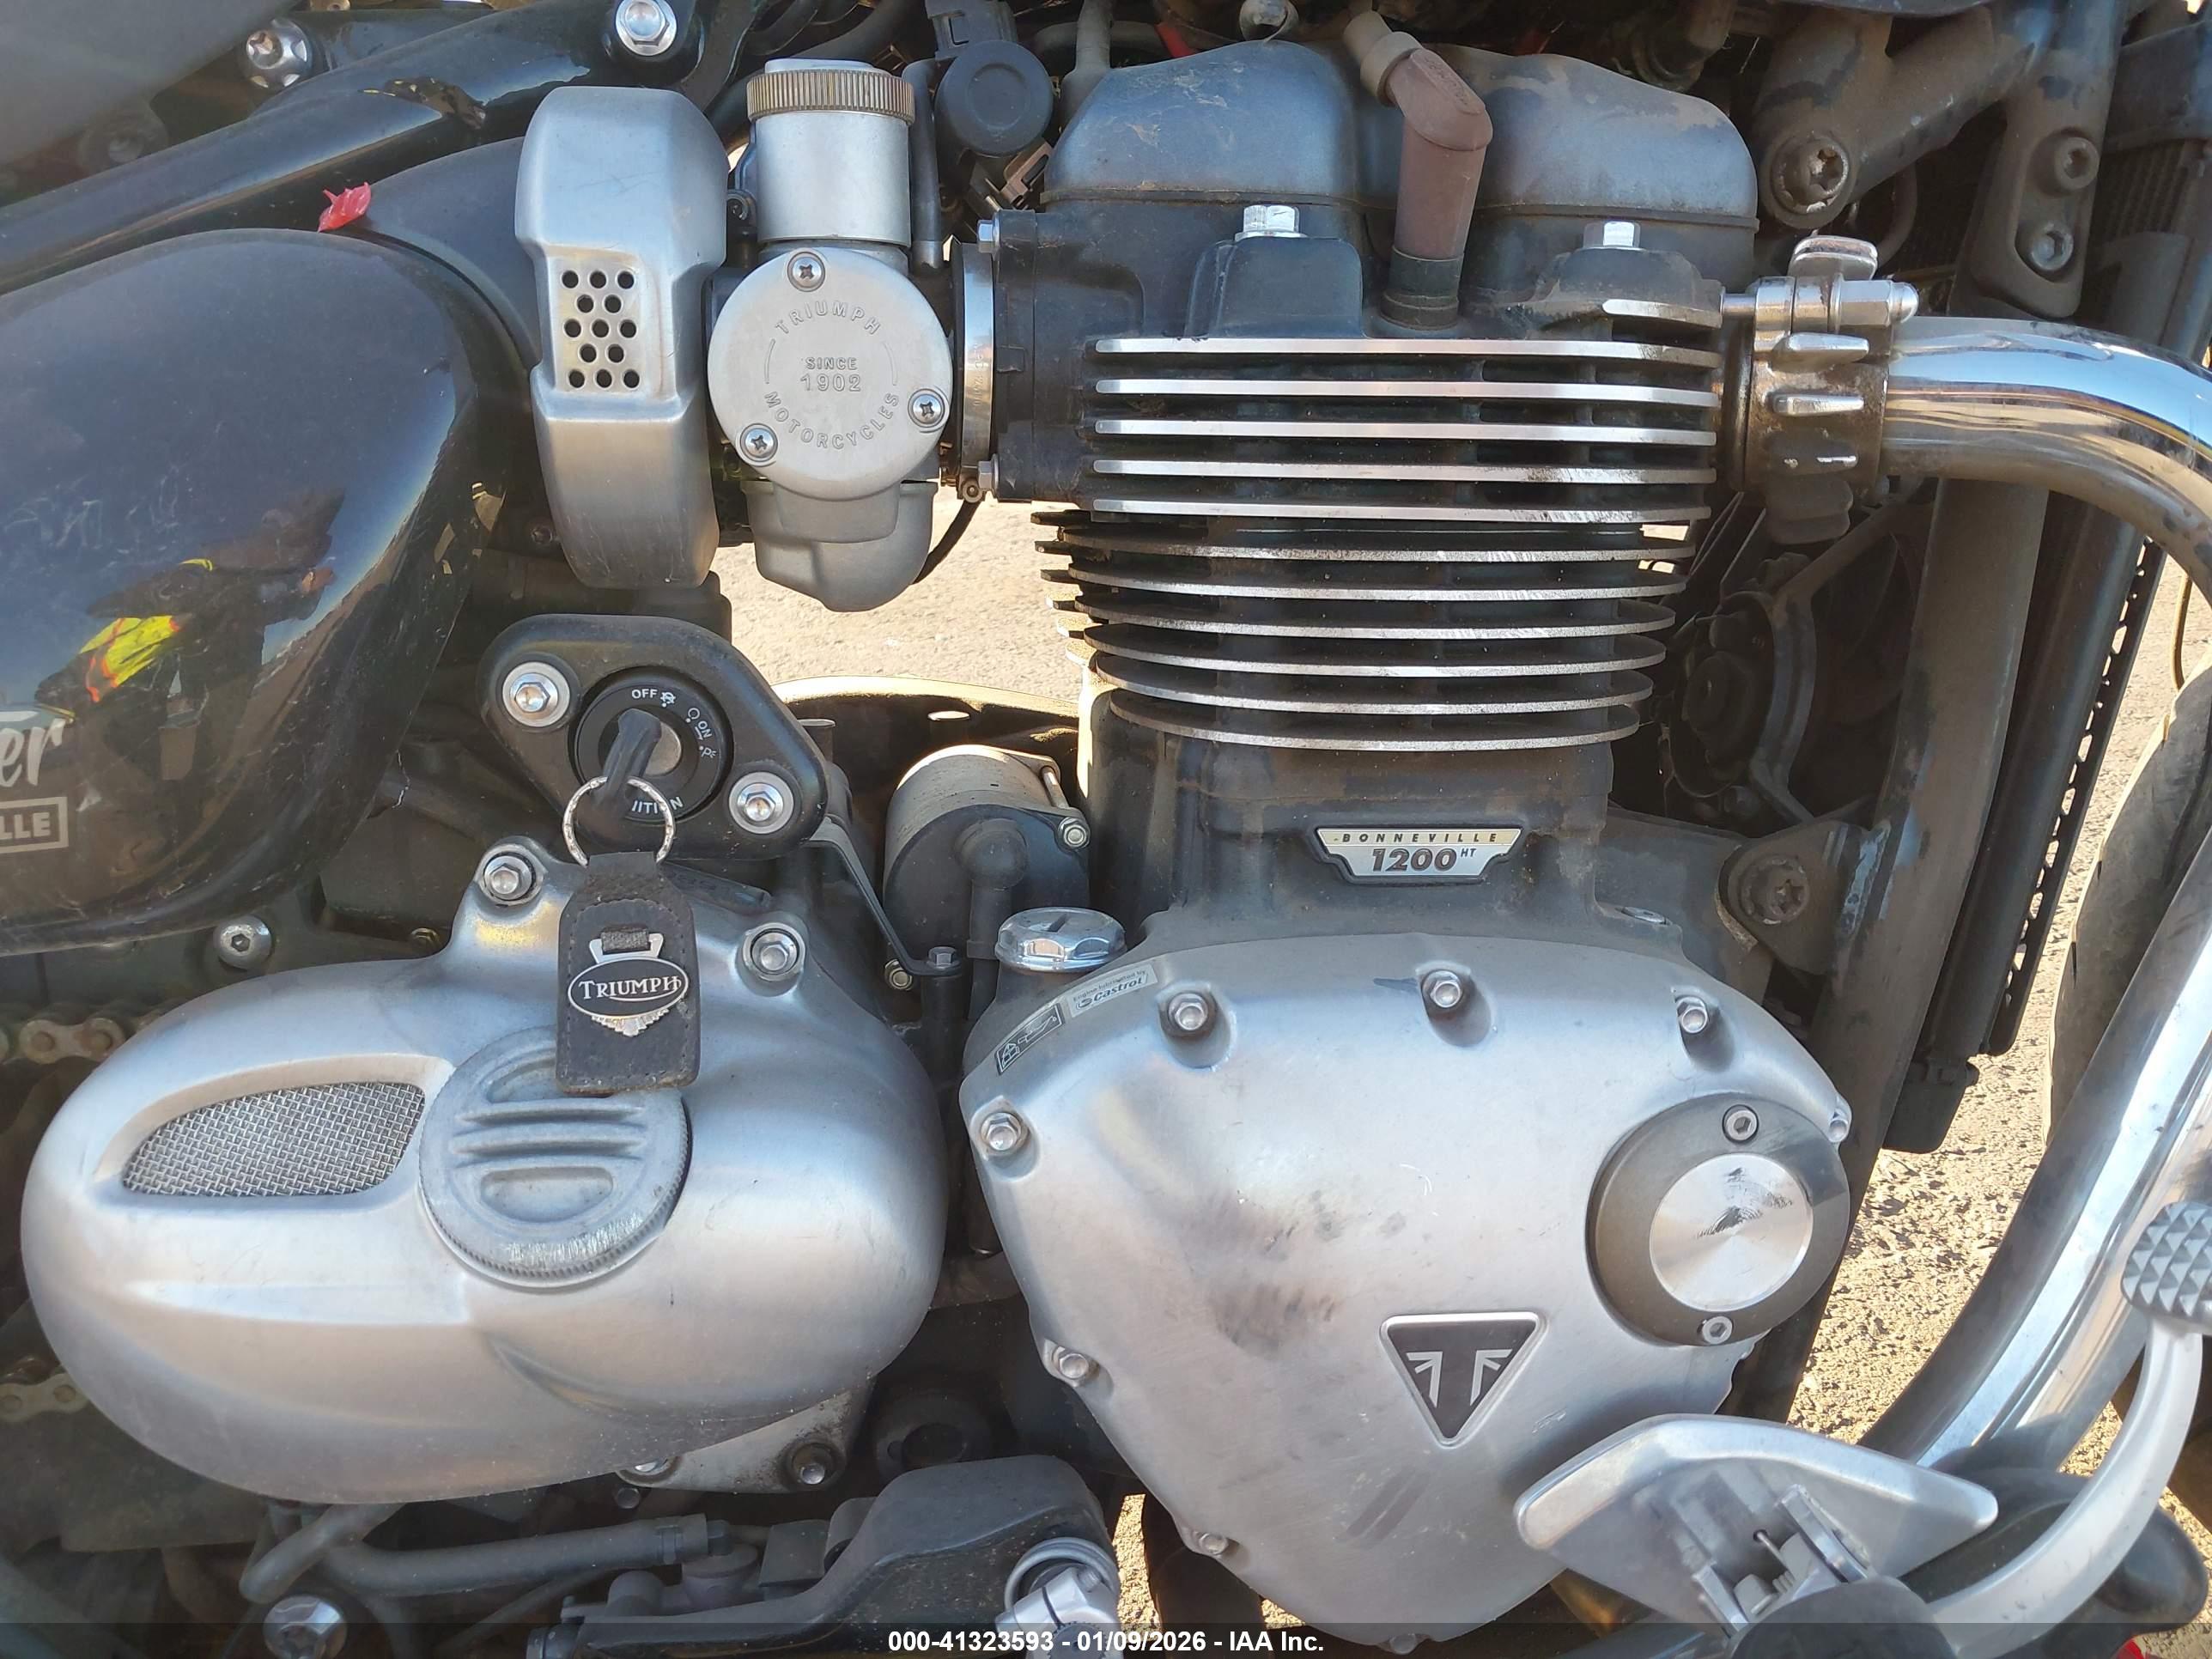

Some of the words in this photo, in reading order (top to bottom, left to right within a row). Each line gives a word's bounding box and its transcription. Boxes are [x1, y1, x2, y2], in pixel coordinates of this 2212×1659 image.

[775, 300, 881, 336] TRIUMPH
[805, 356, 858, 370] SINCE
[800, 374, 861, 392] 1902
[763, 392, 900, 450] MOTORCYCLES
[631, 688, 658, 700] OFF
[697, 720, 713, 739] ON
[1341, 832, 1498, 843] BONNEVILLE
[1371, 848, 1457, 872] 1200
[1461, 848, 1477, 858] HT
[579, 975, 682, 1000] TRIUMPH
[1093, 977, 1143, 1002] Castrol
